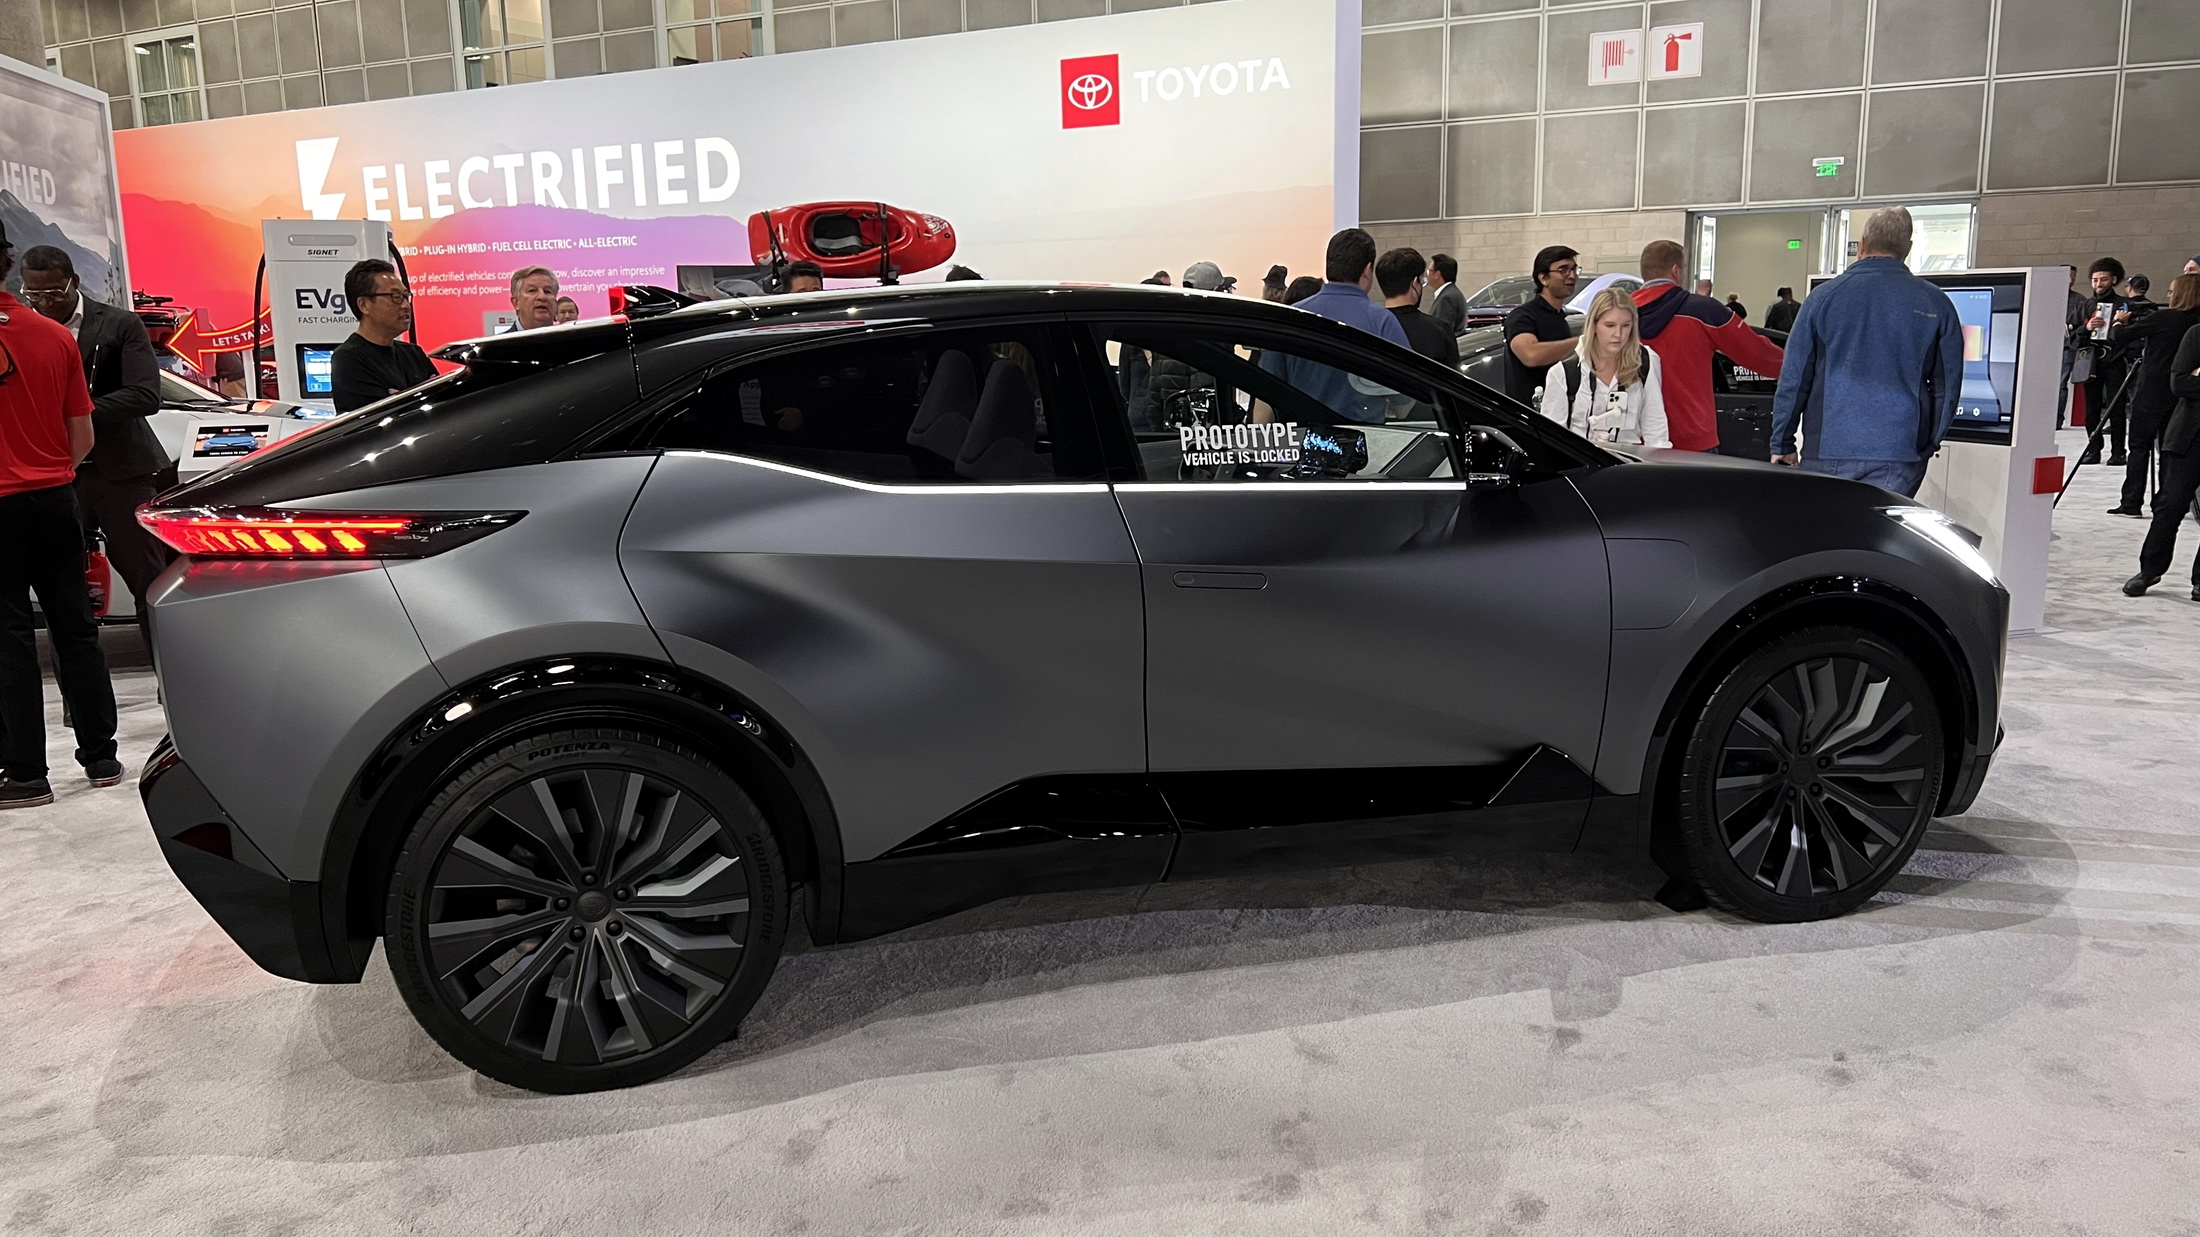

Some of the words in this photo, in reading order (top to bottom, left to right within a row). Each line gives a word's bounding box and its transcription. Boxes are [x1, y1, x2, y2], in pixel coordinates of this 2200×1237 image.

[1133, 57, 1291, 102] TOYOTA
[2, 160, 56, 205] IFIED
[362, 136, 741, 222] ELECTRIFIED
[397, 246, 418, 257] BRID
[424, 245, 456, 256] PLUG-IN
[458, 243, 487, 254] HYBRID
[492, 241, 512, 252] FUEL
[513, 240, 533, 251] CELL
[534, 239, 573, 250] ELECTRIC
[579, 236, 638, 248] ALL-ELECTRIC
[420, 272, 427, 282] of
[428, 271, 464, 282] electrified
[465, 270, 496, 281] vehicles
[572, 267, 605, 277] discover
[608, 268, 617, 277] an
[620, 265, 666, 278] impressive
[418, 287, 427, 296] of
[427, 286, 461, 297] efficiency
[463, 285, 478, 295] and
[558, 282, 594, 293] owertrain
[296, 288, 347, 314] EVg
[298, 316, 318, 324] FAST
[320, 316, 359, 324] CHARGIN
[212, 334, 241, 347] LET'S
[241, 323, 271, 342] TAK!
[1180, 422, 1300, 450] PROTOTYPE
[1183, 452, 1235, 466] VEHICLE
[1238, 451, 1251, 463] IS
[1254, 449, 1300, 463] LOCKED
[528, 742, 610, 761] POTENZA
